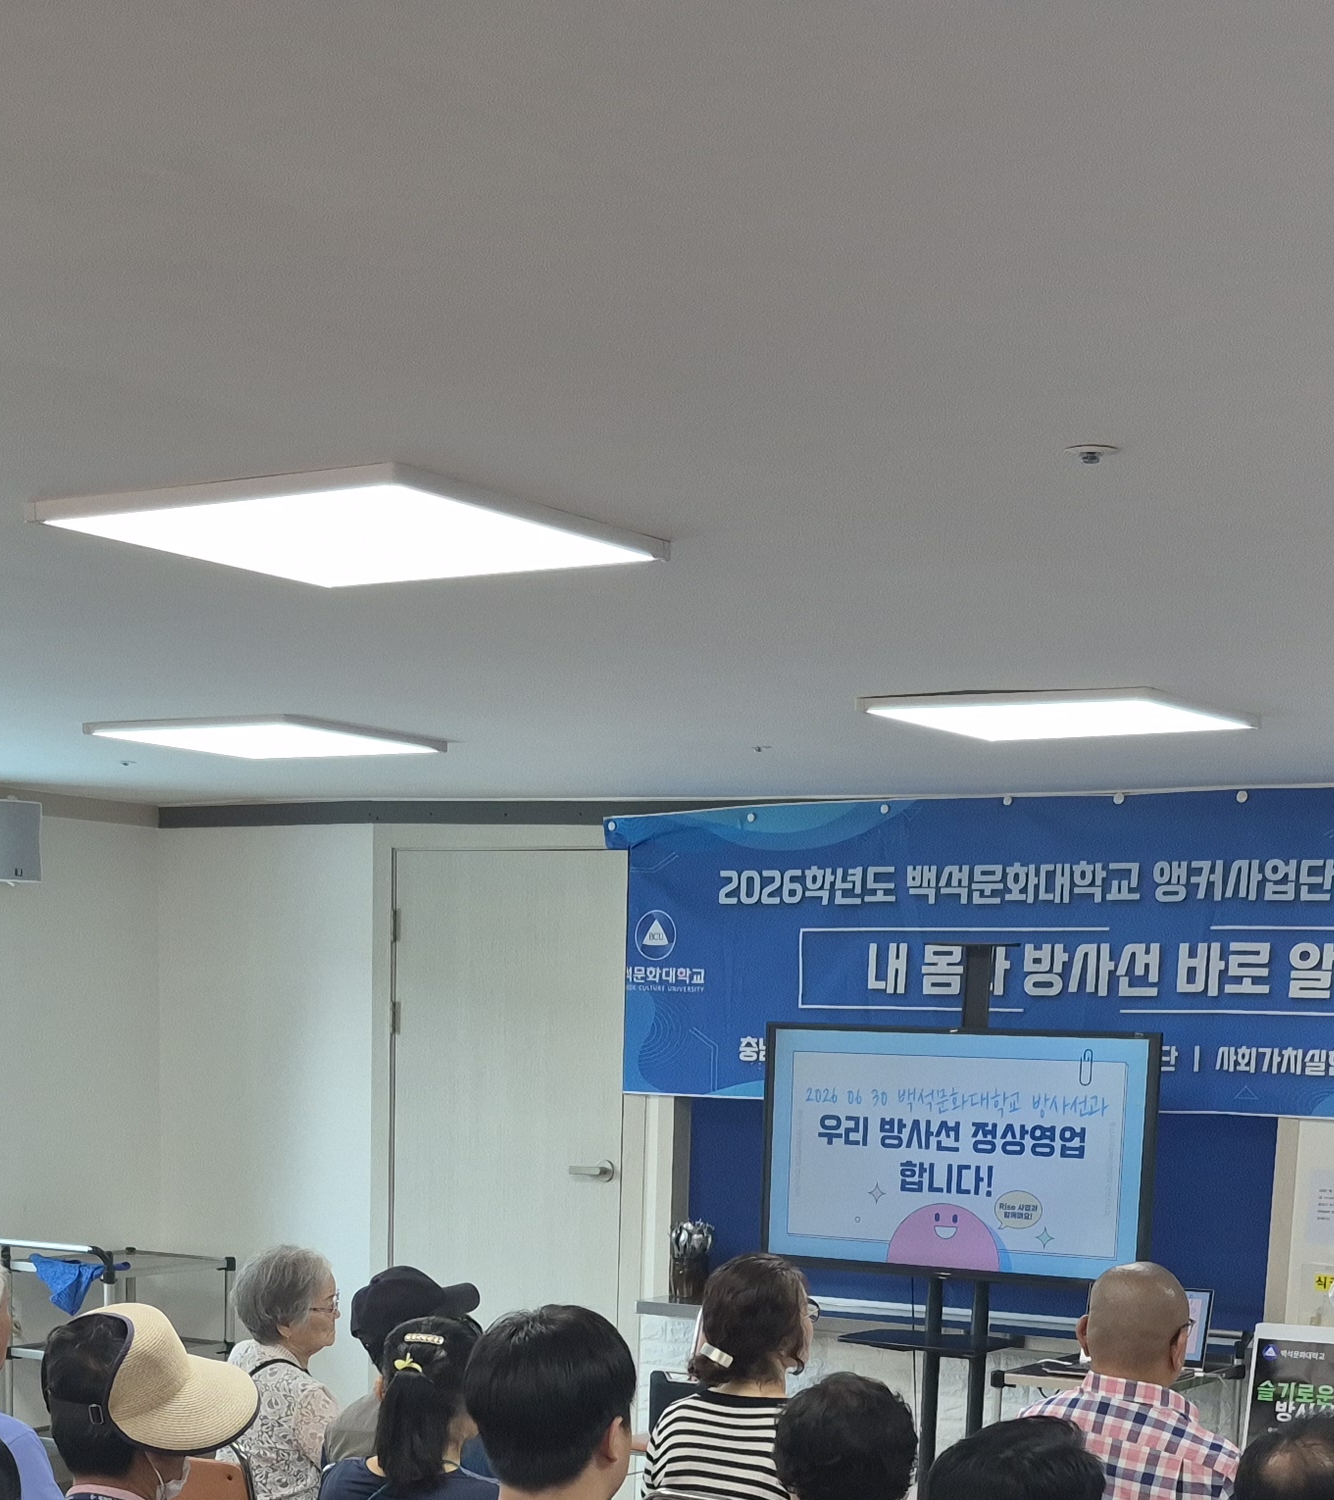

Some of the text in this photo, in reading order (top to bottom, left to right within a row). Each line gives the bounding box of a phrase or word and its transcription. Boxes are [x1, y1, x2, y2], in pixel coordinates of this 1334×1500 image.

[718, 865, 896, 905] 2026학년도
[906, 861, 1140, 904] 백석문화대학교
[867, 942, 908, 994] 내
[1023, 942, 1160, 997] 방사선
[1176, 942, 1271, 997] 바로
[805, 1087, 1110, 1119] 2026 06 30 백석문화대학교 방사선과
[818, 1114, 1087, 1160] 우리 방사선 정상영업
[899, 1160, 994, 1198] 합니다!
[1257, 1380, 1334, 1406] 슬기로운
